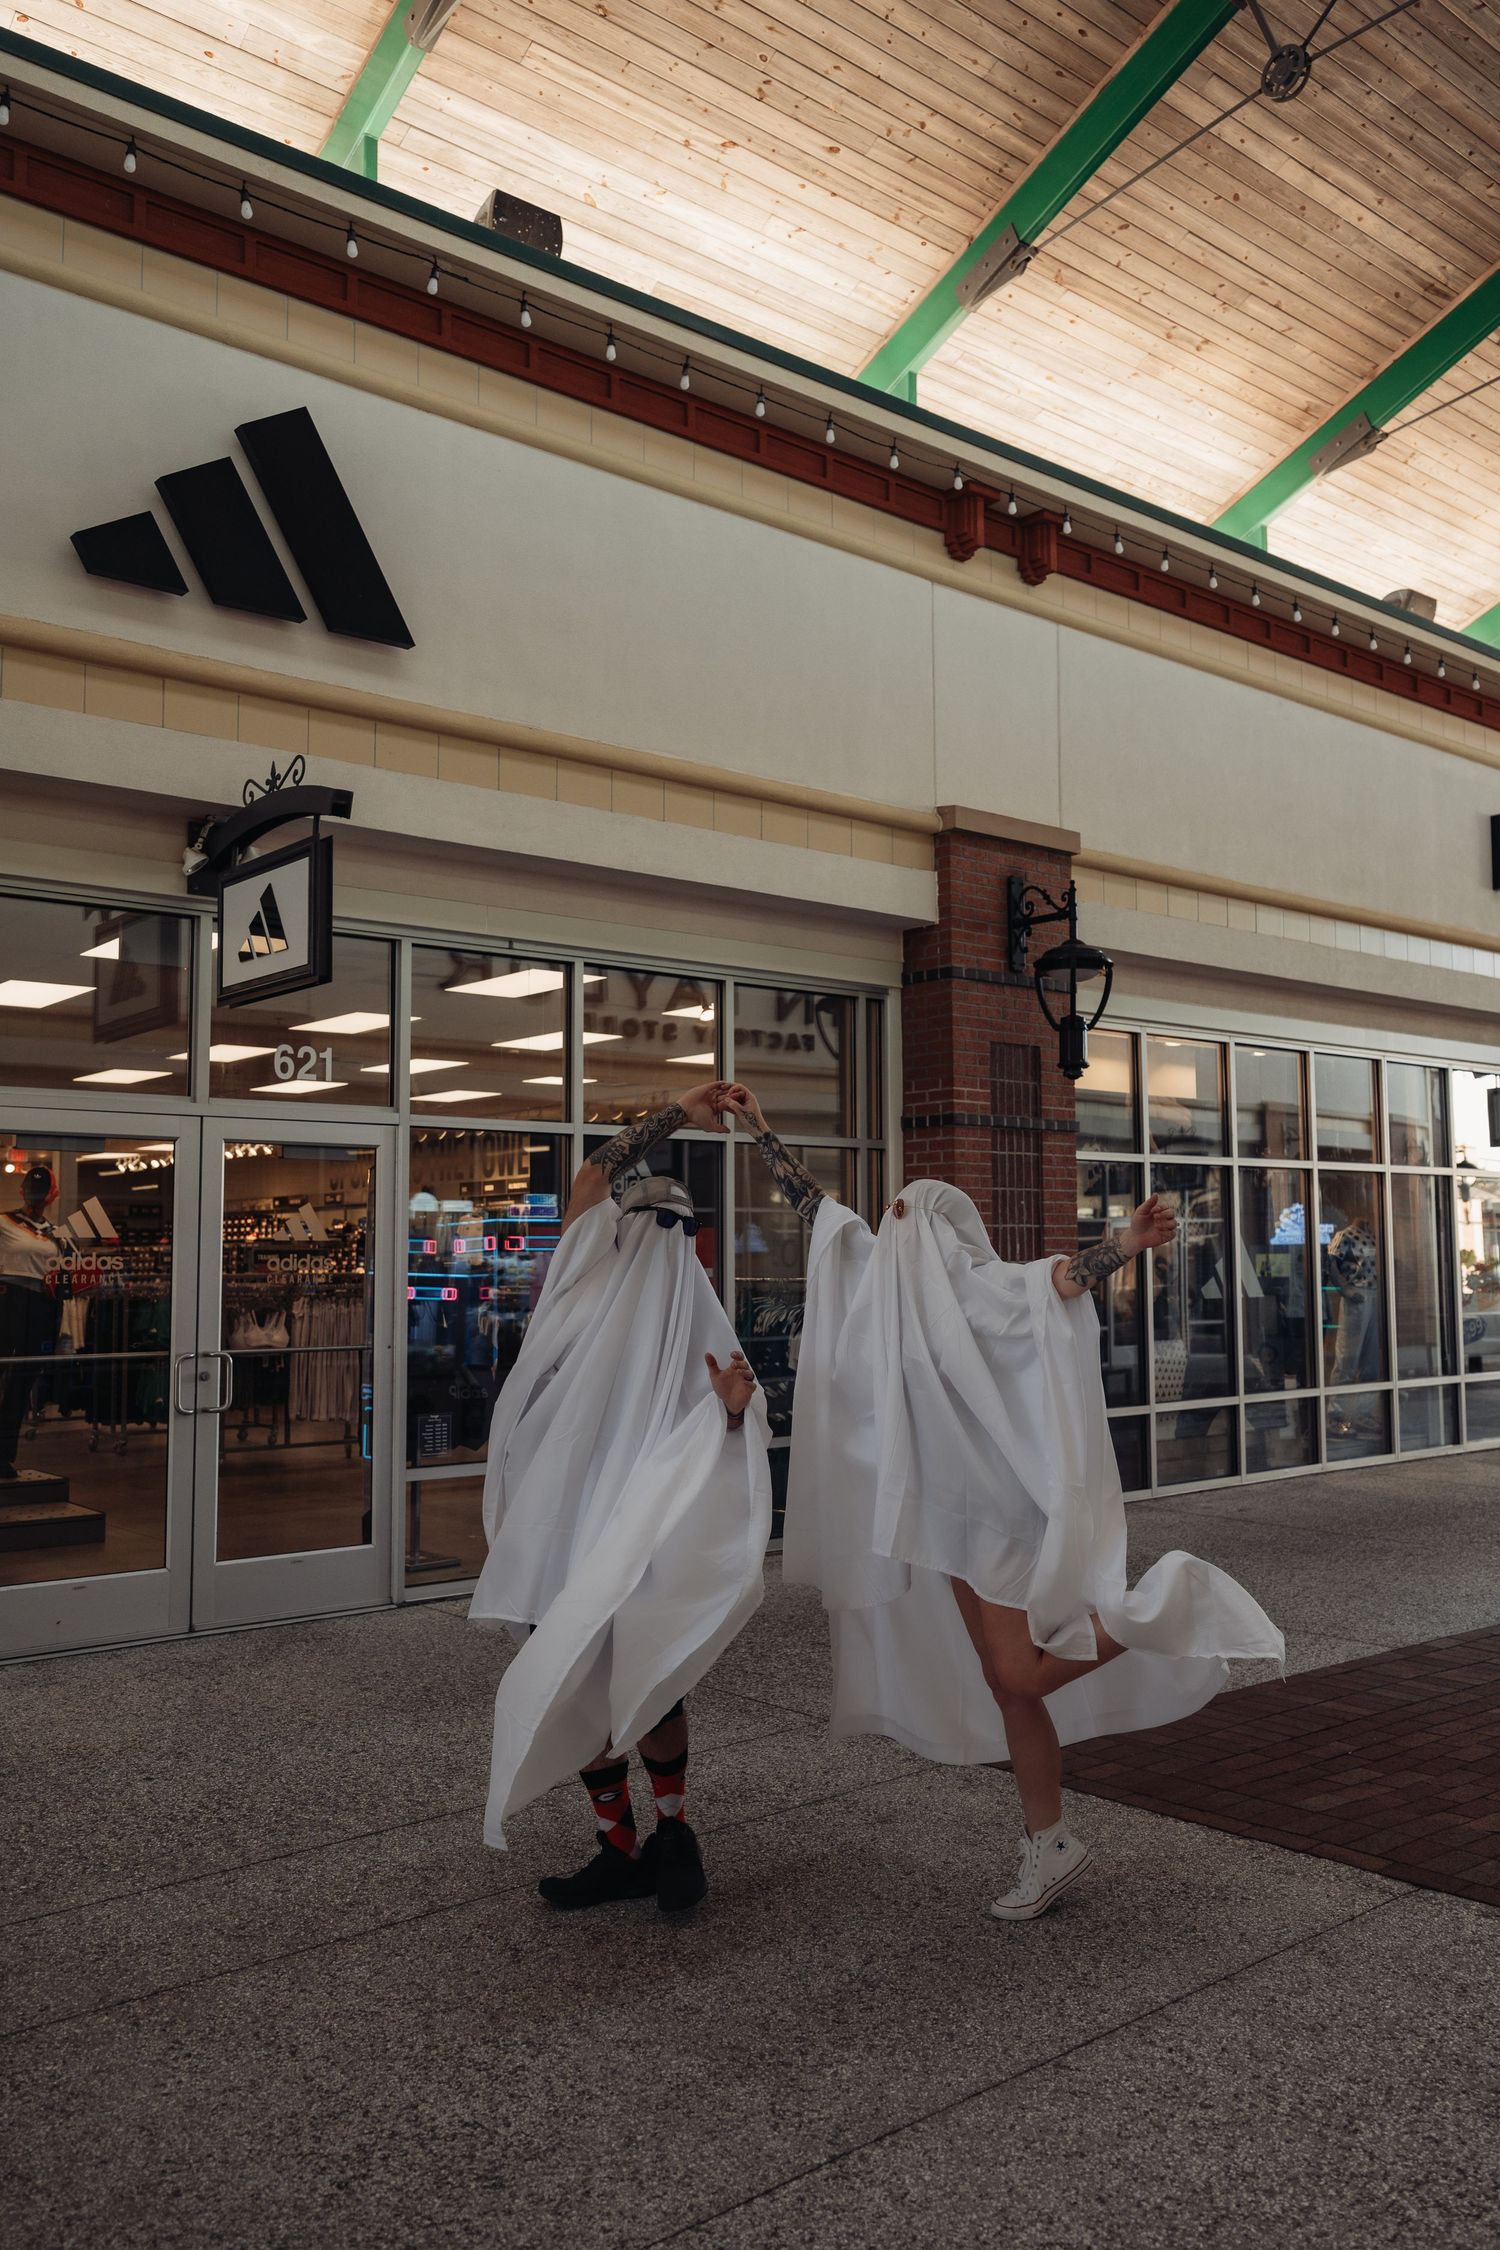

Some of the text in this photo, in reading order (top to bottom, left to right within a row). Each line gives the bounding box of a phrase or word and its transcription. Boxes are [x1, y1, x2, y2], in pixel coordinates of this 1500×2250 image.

[273, 1043, 333, 1081] 621
[46, 1251, 124, 1270] adidas
[266, 1253, 334, 1271] adidas
[45, 1272, 124, 1286] CLEARANCE
[266, 1273, 334, 1284] CLEARANCE
